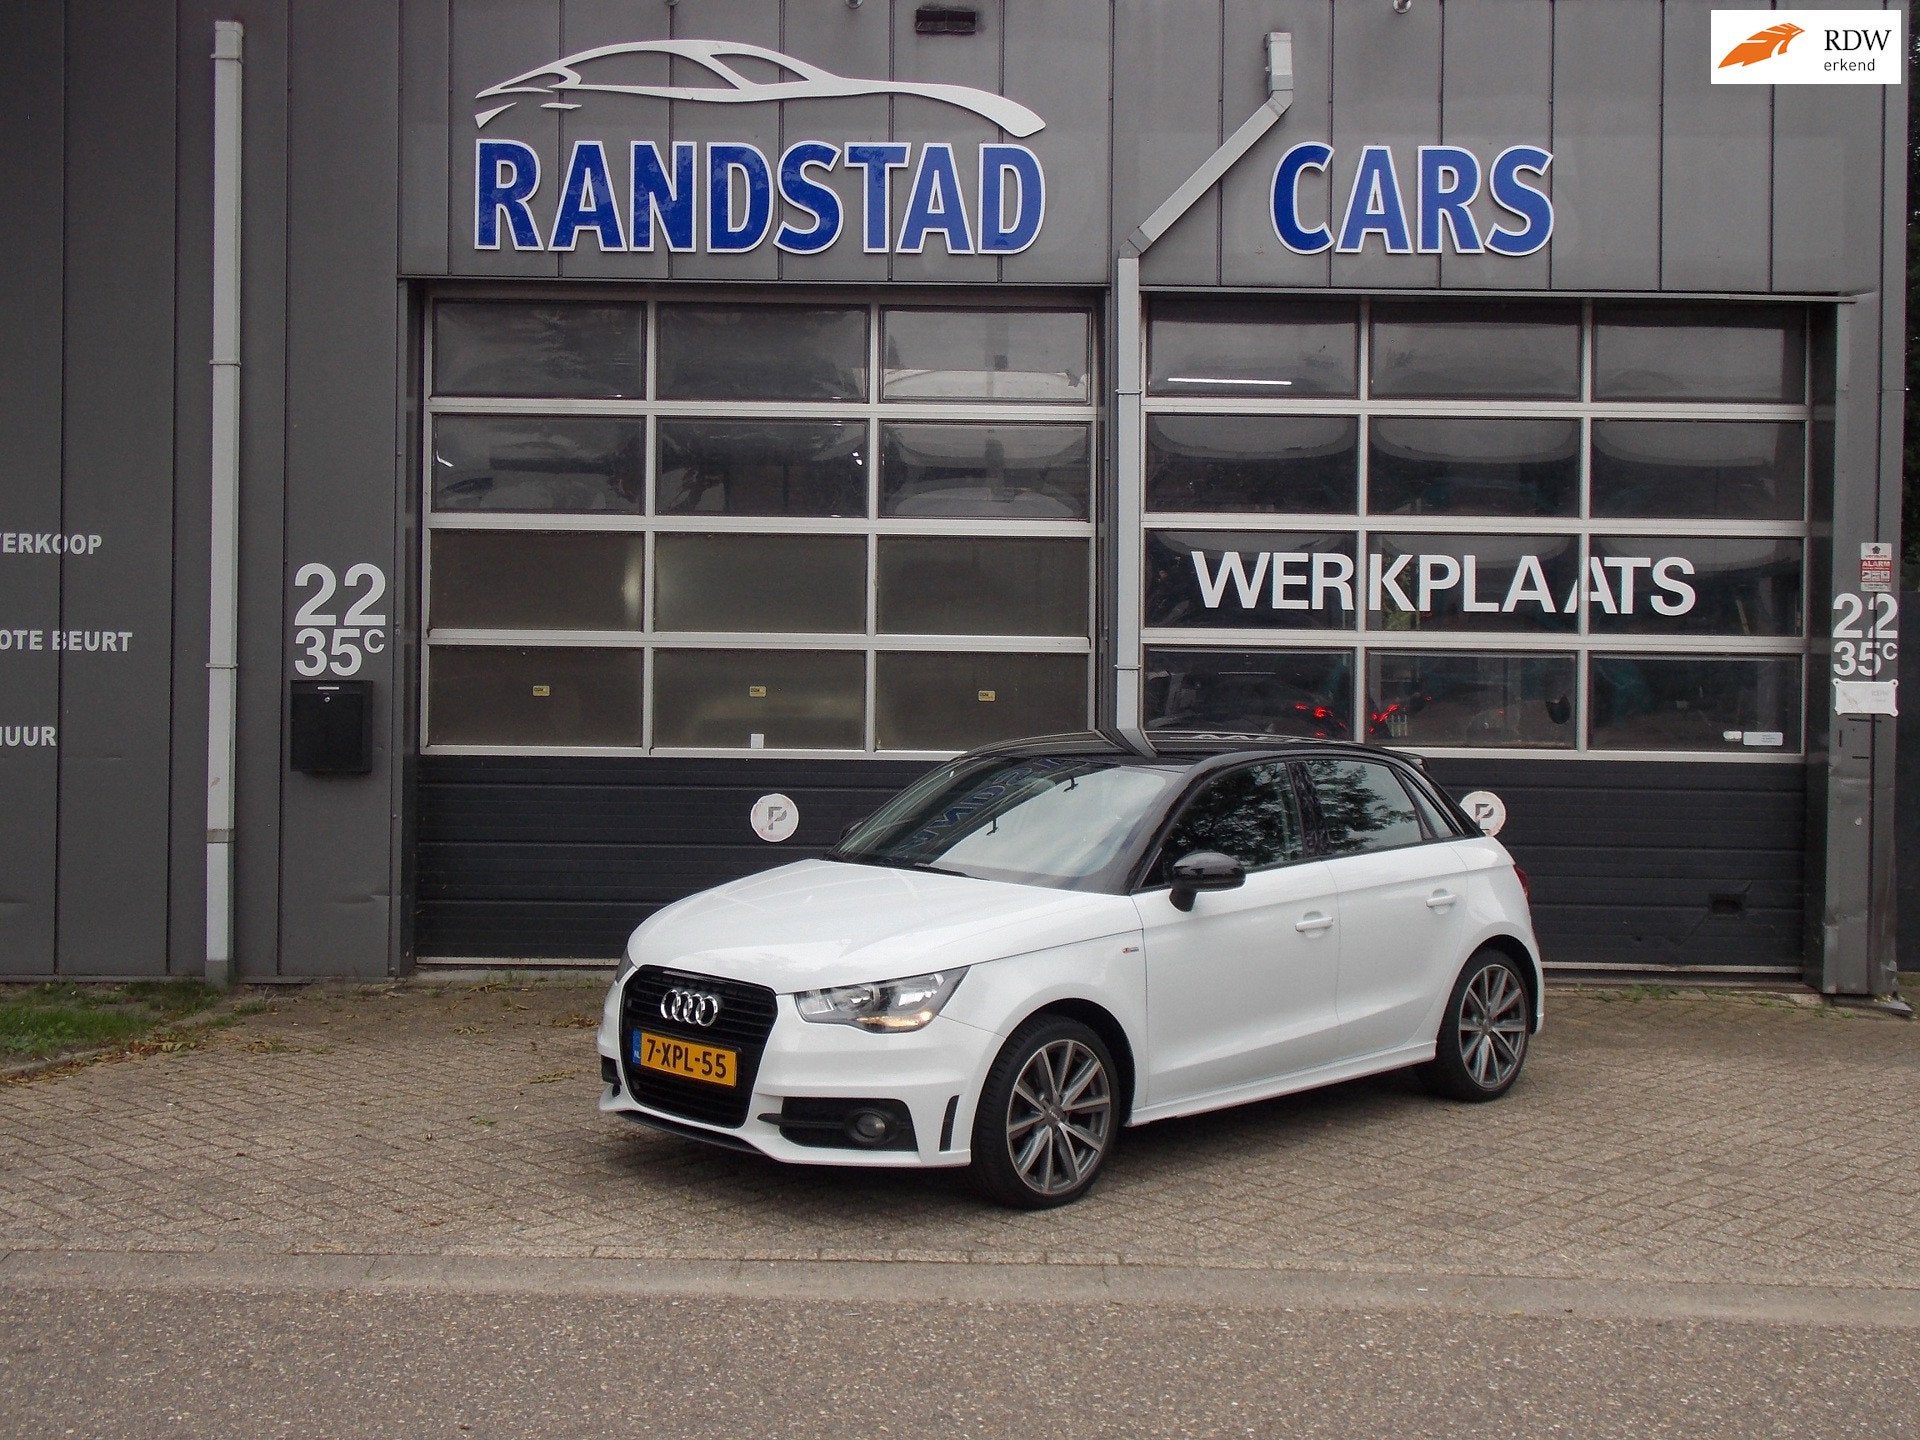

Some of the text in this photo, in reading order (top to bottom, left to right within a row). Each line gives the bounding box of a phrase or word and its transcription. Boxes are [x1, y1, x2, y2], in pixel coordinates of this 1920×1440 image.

[474, 138, 1555, 258] RANDSTAD CARS
[0, 533, 103, 555] ERKOOP
[294, 562, 386, 626] 22
[1191, 551, 1696, 616] WERKPLAATS
[1832, 593, 1898, 638] 22
[52, 630, 133, 652] BEURT
[646, 1038, 727, 1079] 7-XPL-55
